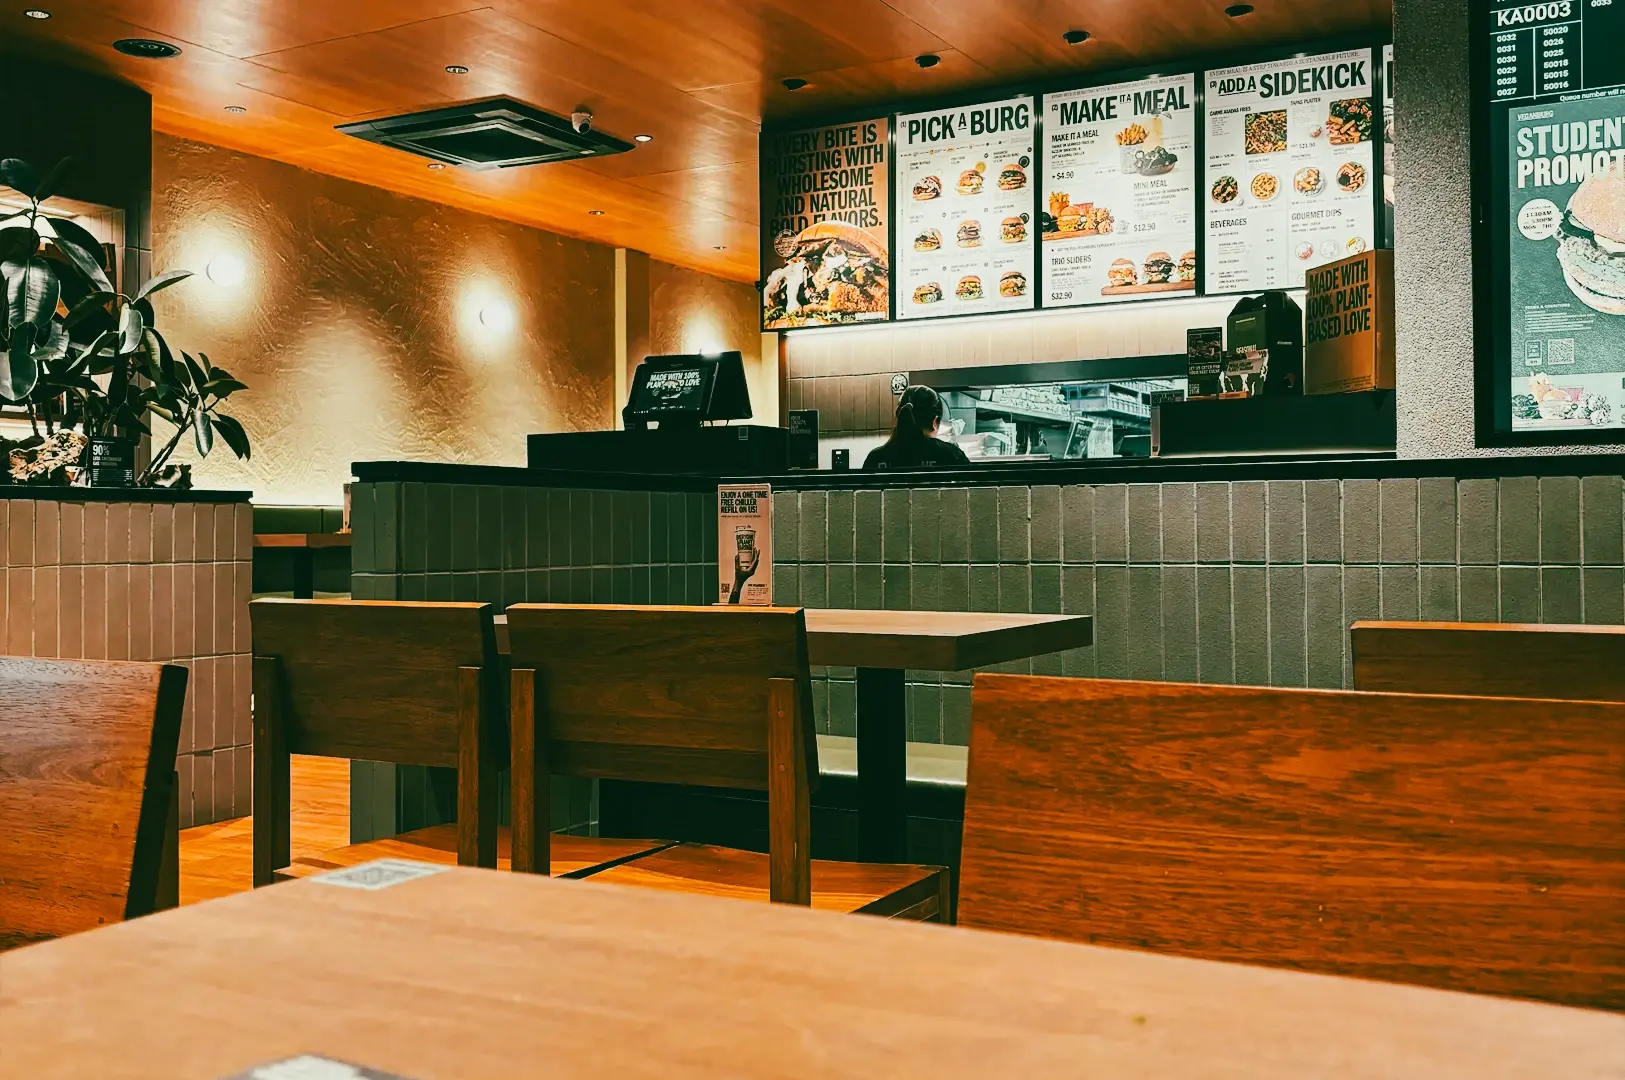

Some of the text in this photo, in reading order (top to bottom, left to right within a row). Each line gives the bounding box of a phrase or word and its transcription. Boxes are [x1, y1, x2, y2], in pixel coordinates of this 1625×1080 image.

[1497, 2, 1571, 26] KA0003
[1543, 26, 1569, 36] 50020
[1496, 33, 1517, 43] 0032
[1543, 38, 1564, 47] 0026
[1496, 44, 1516, 53] 0031
[1543, 49, 1564, 58] 0025
[1496, 55, 1517, 64] 0030
[1543, 59, 1569, 69] 50018
[1496, 66, 1517, 75] 0029
[1543, 70, 1569, 80] 50015
[1218, 77, 1245, 94] ADD
[1247, 76, 1256, 90] A
[1259, 61, 1367, 98] SIDEKICK
[1496, 77, 1517, 86] 0028
[1543, 81, 1569, 91] 50016
[1496, 88, 1517, 97] 0027
[1560, 93, 1581, 102] Queue
[1582, 90, 1606, 99] number
[1607, 88, 1619, 97] will
[1060, 95, 1118, 126] MAKE
[1120, 94, 1127, 103] IT
[1126, 94, 1132, 102] A
[1133, 86, 1190, 116] MEAL
[1517, 110, 1554, 120] VEGANBURG
[908, 113, 956, 145] PICK
[958, 112, 967, 128] A
[970, 104, 1029, 136] BURG
[774, 123, 878, 154] EVERY BITE IS
[1051, 129, 1099, 142] MAKE IT A MEAL
[1516, 116, 1625, 158] STUDEN
[767, 143, 884, 176] BURSTING WITH
[777, 166, 874, 197] WHOLESOME
[1133, 179, 1168, 190] MINI MEAL
[774, 187, 877, 218] AND NATURAL
[1291, 208, 1342, 221] GOURMET DIPS
[1133, 222, 1156, 232] $12.90
[1210, 218, 1248, 229] BEVERAGES
[1051, 254, 1092, 266] TRIO SLIDERS
[1309, 258, 1369, 296] MADE WITH
[1051, 291, 1073, 301] $32.90
[1306, 283, 1372, 319] 100% PLANT-
[1307, 307, 1371, 343] BASED LOVE
[650, 371, 700, 382] MADE WITH 100%
[685, 378, 701, 387] LOVE
[93, 444, 110, 456] 90%
[720, 490, 768, 499] ENJOY A ONE TIME
[720, 498, 757, 506] FREE CHILLER
[720, 506, 738, 514] REFILL
